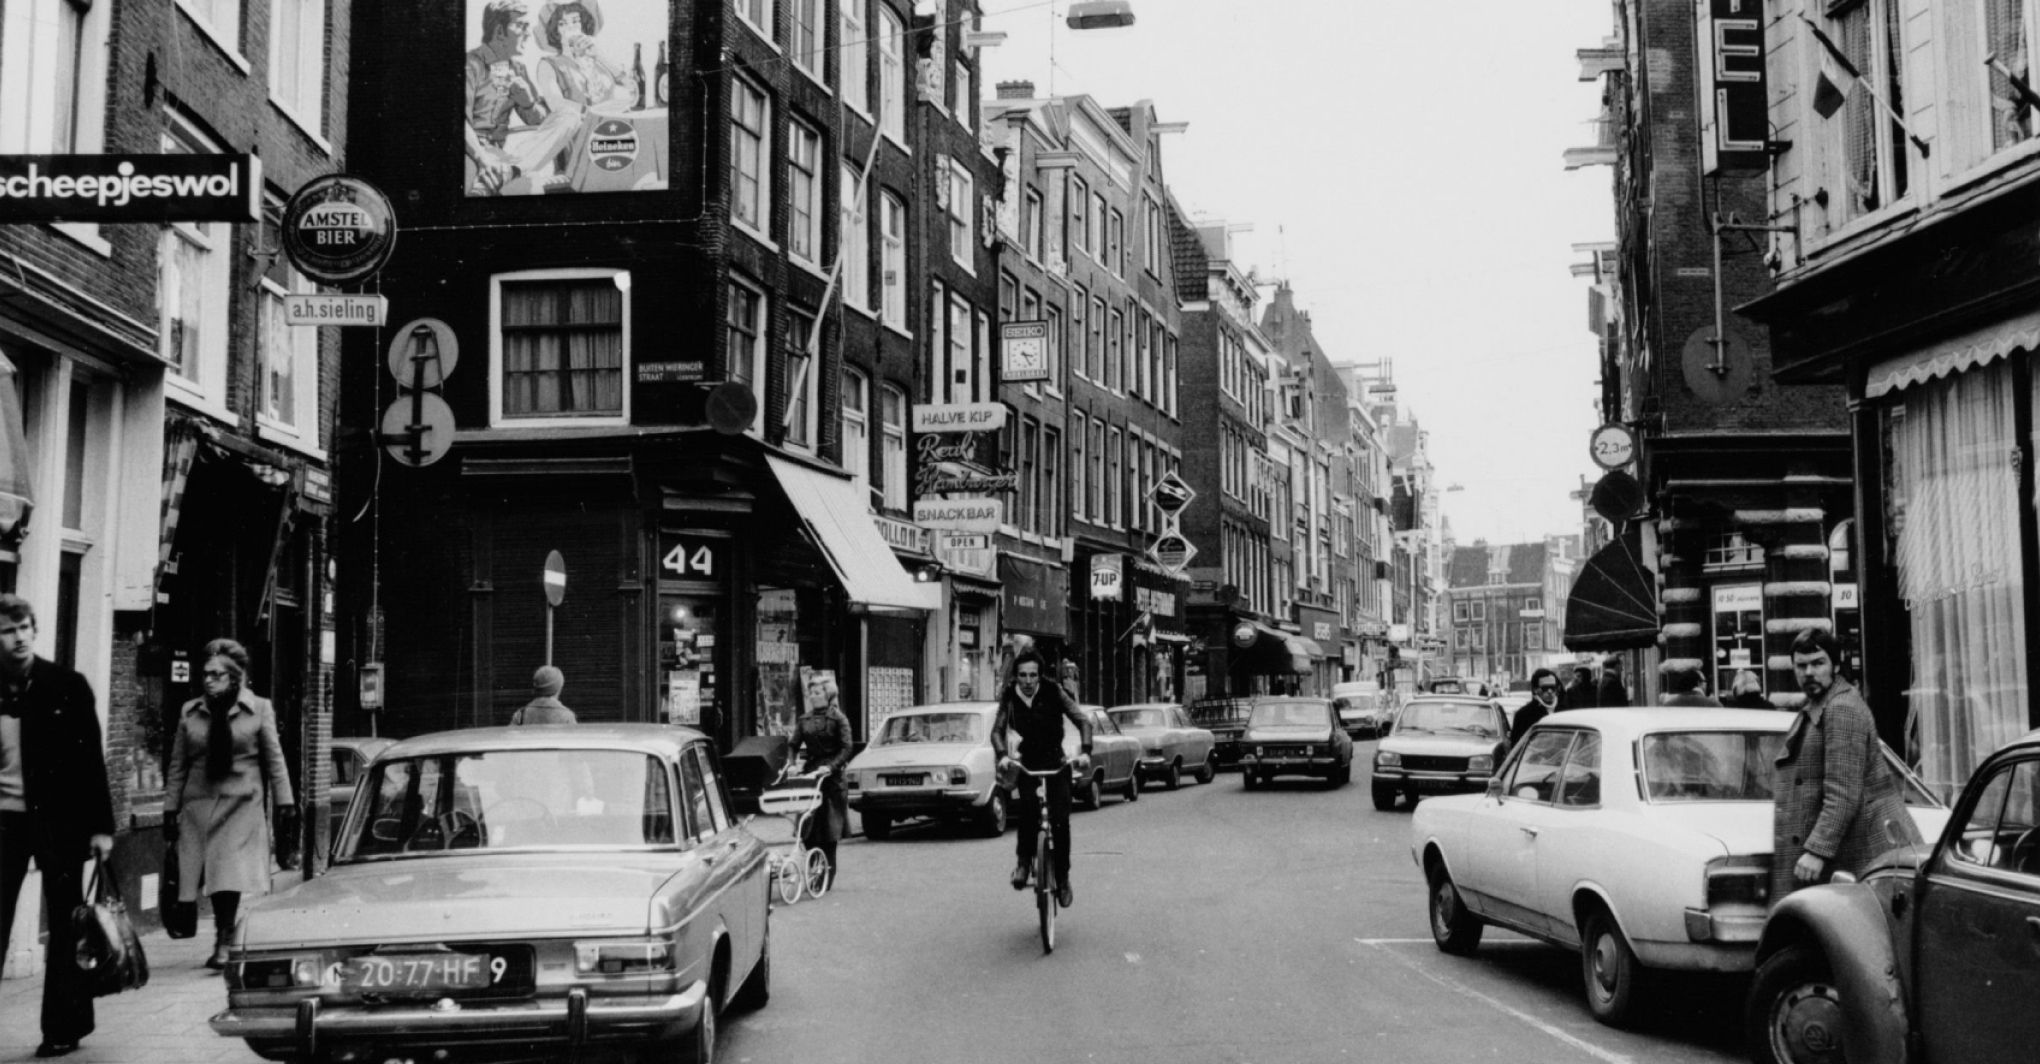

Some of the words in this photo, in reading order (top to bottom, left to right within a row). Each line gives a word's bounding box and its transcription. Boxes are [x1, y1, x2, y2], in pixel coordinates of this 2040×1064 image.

[1714, 0, 1764, 151] EL
[592, 140, 634, 151] Heineken
[0, 161, 238, 206] cheepjeswol
[304, 212, 368, 226] AMSTEL
[317, 230, 356, 245] BIER
[1006, 327, 1044, 338] SEIKO
[639, 373, 663, 382] STRAAT
[921, 411, 966, 425] HALVE
[970, 410, 993, 423] KIP
[917, 507, 996, 521] SNACKBAR
[951, 538, 975, 547] OPEN
[662, 543, 712, 576] 44
